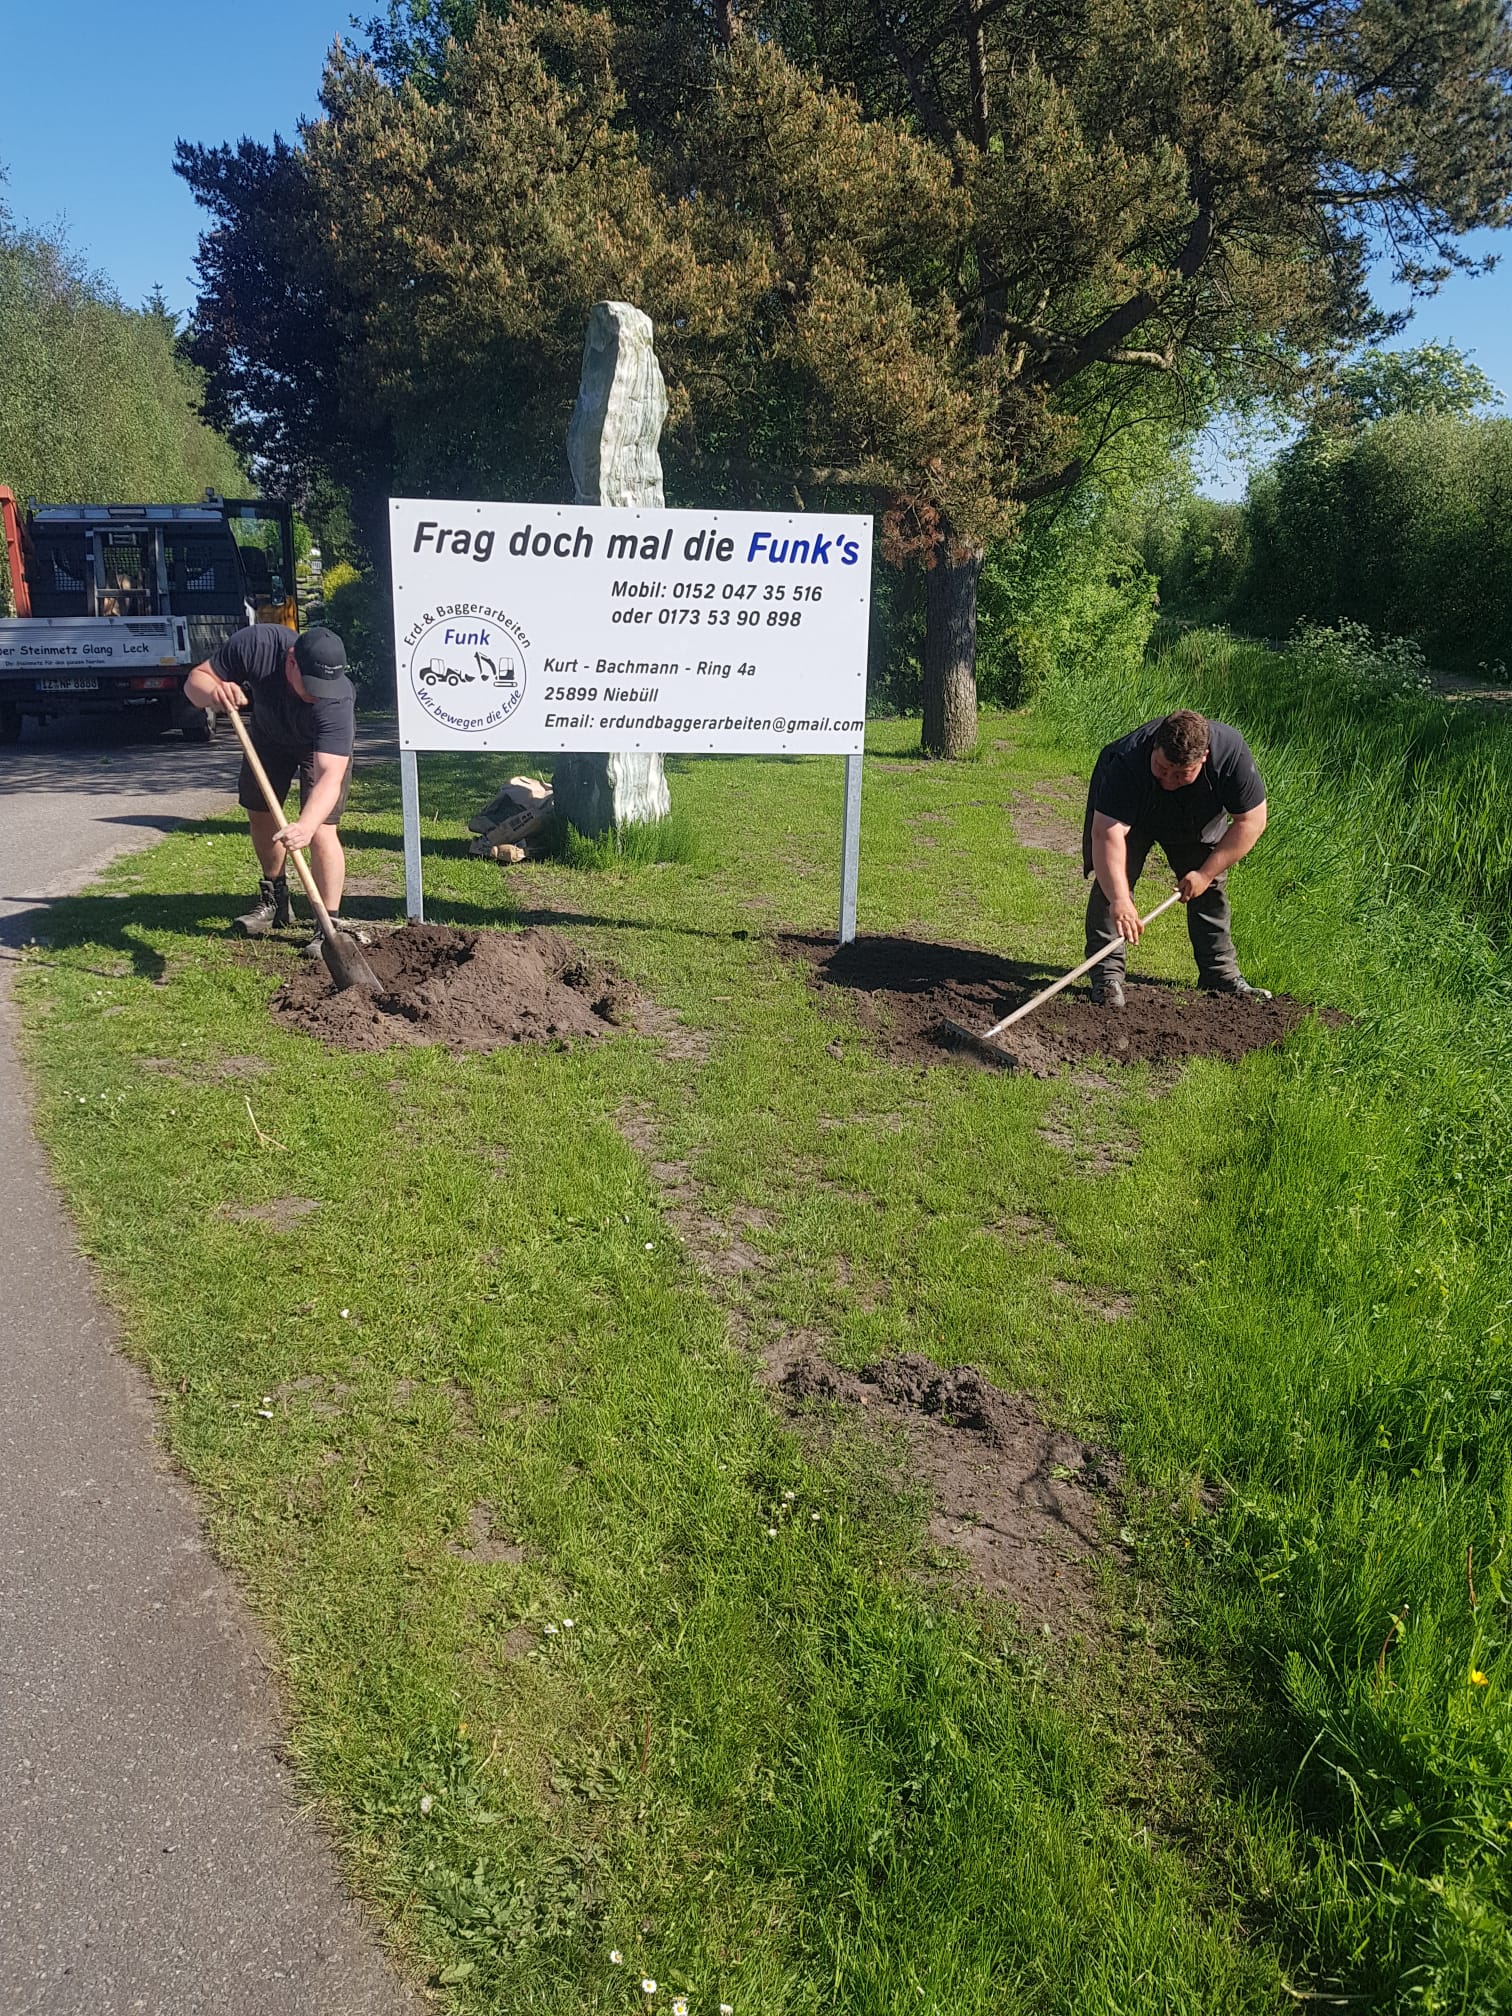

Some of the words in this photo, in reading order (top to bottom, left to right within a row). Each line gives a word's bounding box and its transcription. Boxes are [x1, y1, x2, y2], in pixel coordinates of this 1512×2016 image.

[413, 521, 495, 562] Frag
[509, 524, 593, 558] doch
[607, 529, 673, 560] mal
[684, 530, 734, 561] die
[747, 532, 859, 565] Funk's
[611, 581, 667, 598] Mobil:
[672, 582, 715, 600] 0152
[722, 584, 757, 600] 047
[763, 585, 786, 601] 35
[792, 586, 823, 602] 516
[436, 603, 531, 649] Baggerarbeiten
[611, 608, 652, 624] oder
[658, 609, 700, 625] 0173
[707, 610, 730, 626] 53
[736, 611, 760, 626] 90
[766, 611, 802, 627] 898
[444, 628, 491, 646] Funk
[20, 645, 78, 656] Steinmetz
[82, 644, 113, 656] Glang
[123, 643, 150, 653] Leck
[544, 658, 578, 673] Kurt
[596, 659, 679, 674] Bachmann
[697, 661, 731, 679] Ring
[737, 662, 756, 676] 4a
[544, 686, 598, 701] 25899
[603, 687, 659, 702] Niebüll
[417, 687, 435, 708] Wir
[433, 705, 484, 730] bewegen
[486, 711, 502, 725] die
[502, 689, 521, 713] Erde
[545, 713, 595, 728] Email:
[600, 714, 864, 734] erdundbaggerarbeiten@gmail.com
